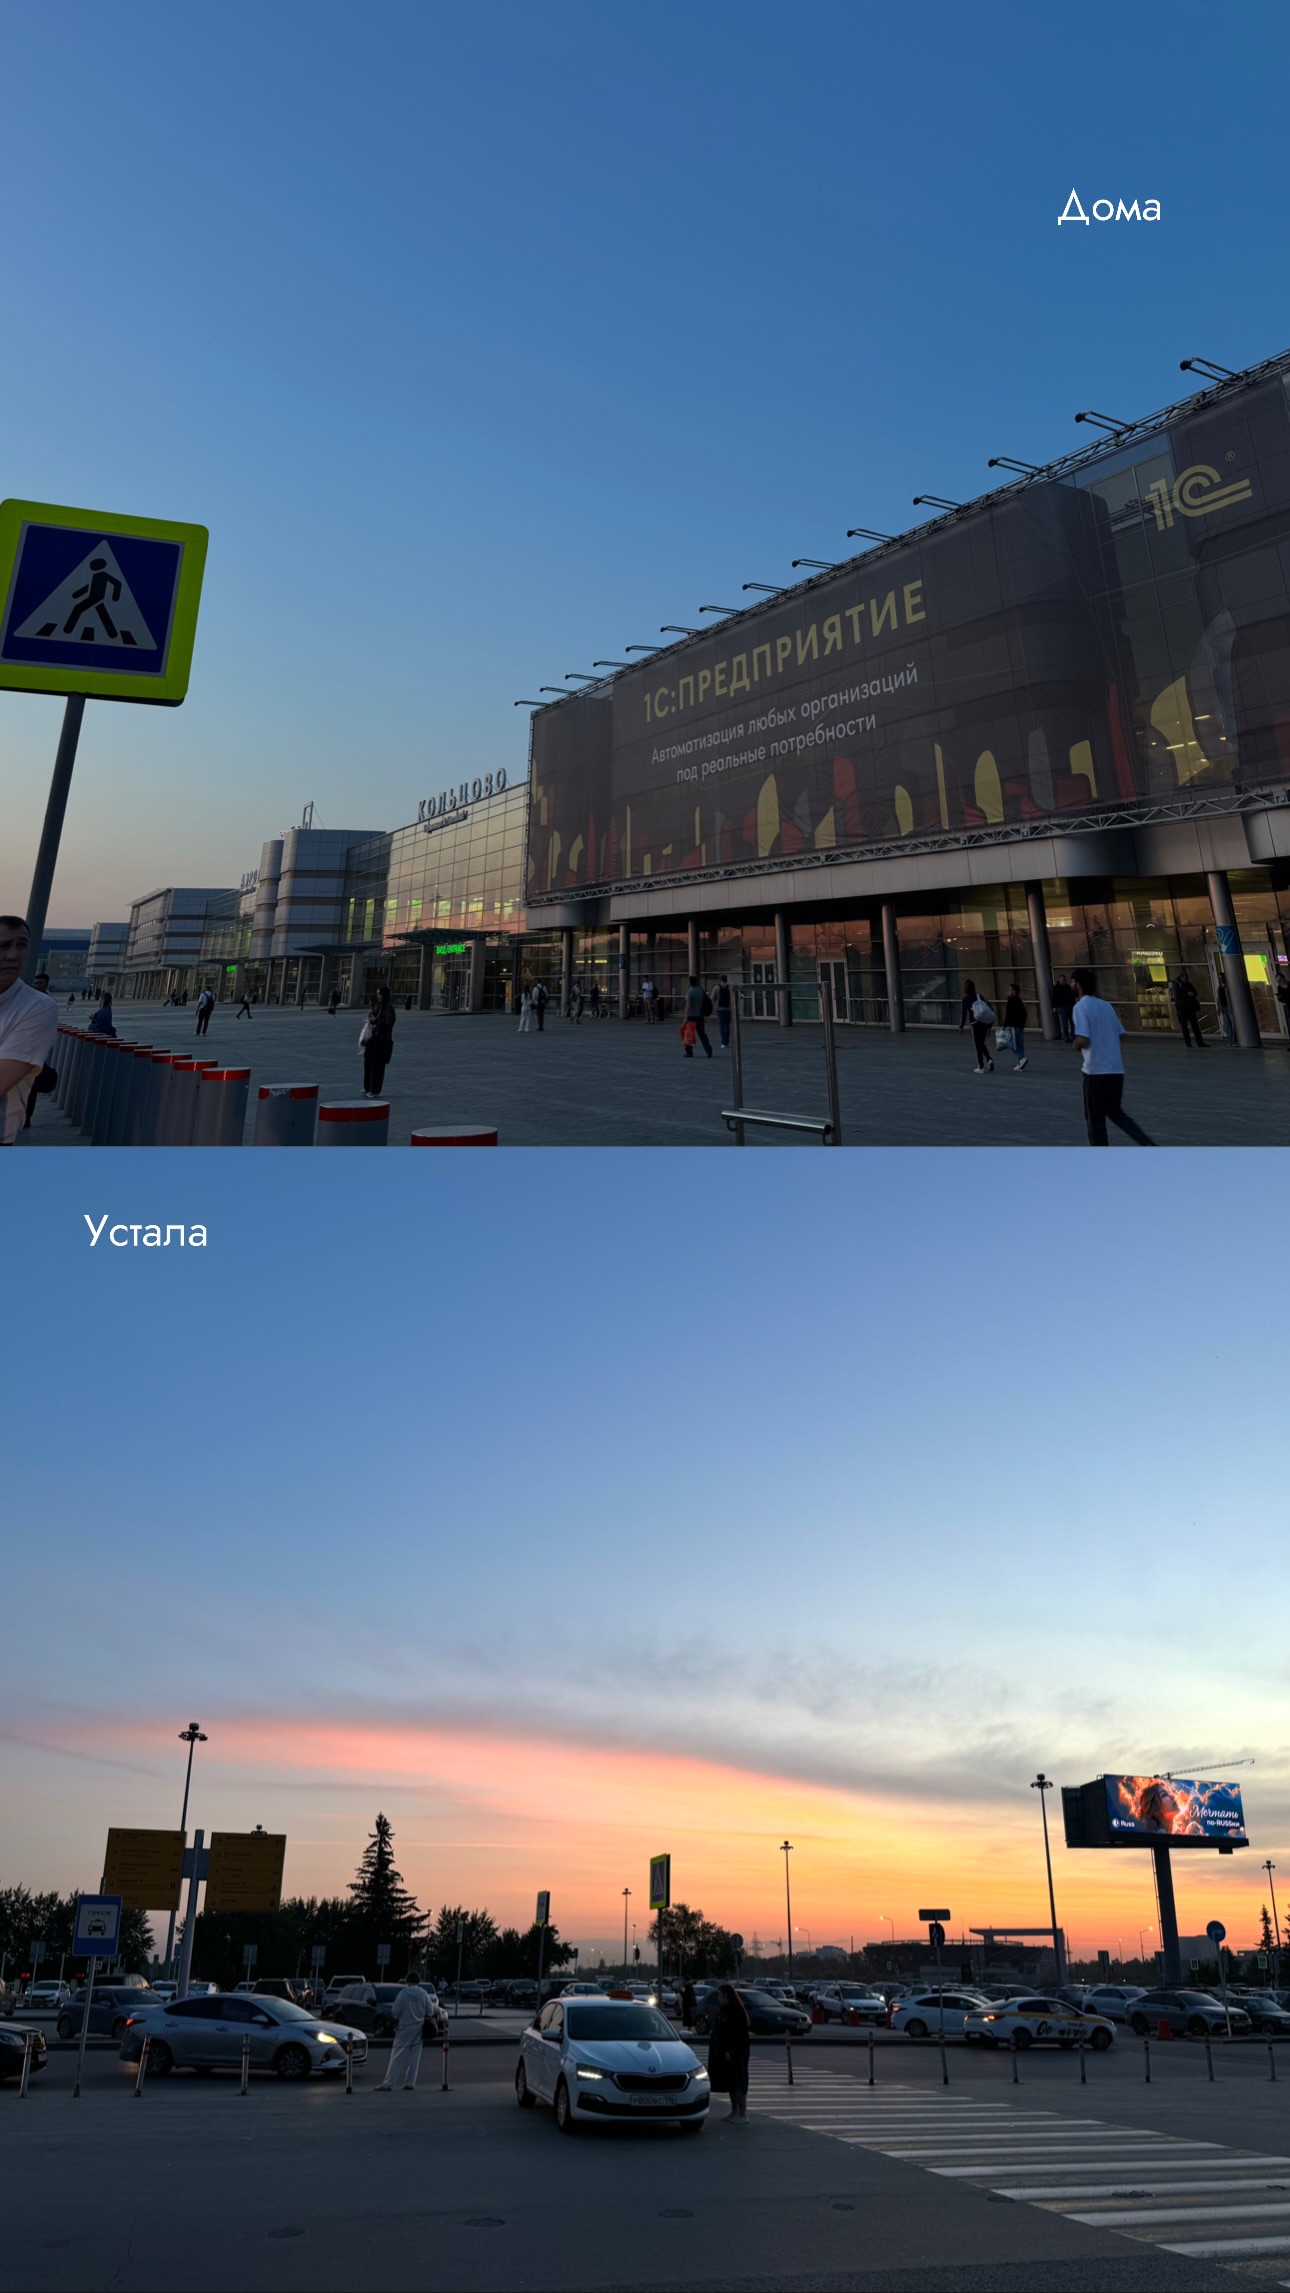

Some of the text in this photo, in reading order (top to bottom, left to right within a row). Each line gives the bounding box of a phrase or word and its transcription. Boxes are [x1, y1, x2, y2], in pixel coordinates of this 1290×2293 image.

[1145, 464, 1253, 532] 1С
[643, 579, 927, 723] 1С:ПРЕДПРИЯТИЕ
[651, 661, 918, 765] Автоматизация любых организаций
[676, 714, 876, 783] под реальные потребности
[418, 767, 507, 822] КОЛЬЦОВО
[1120, 1820, 1135, 1828] Russ
[1189, 1804, 1239, 1819] Мечтать
